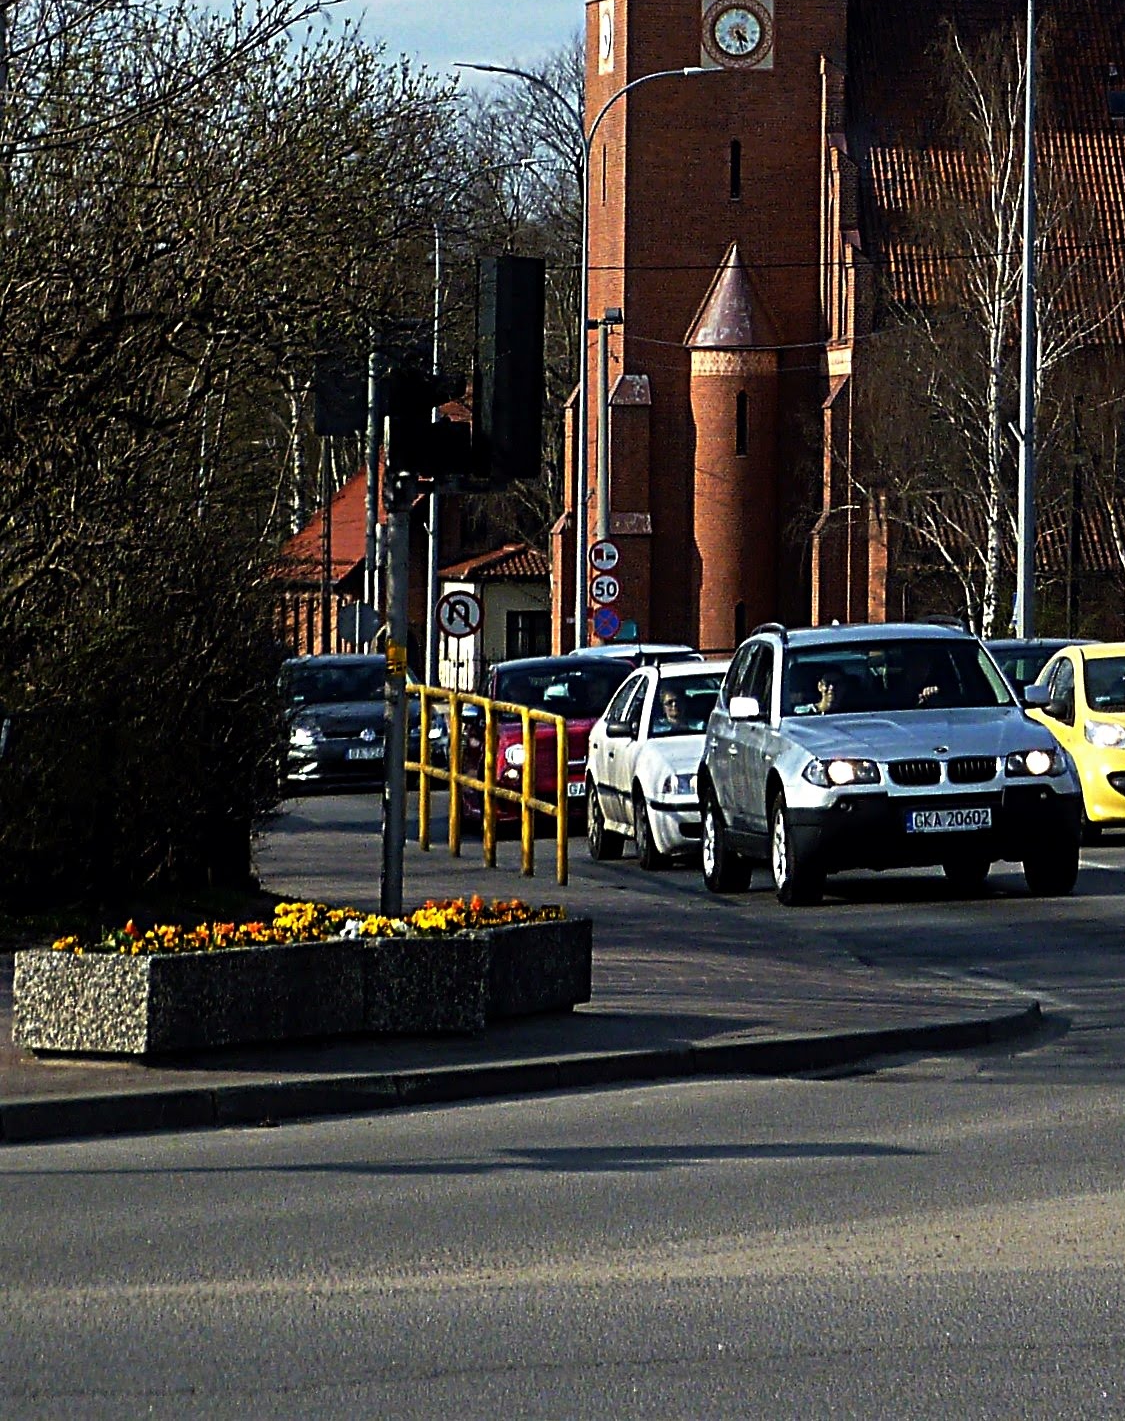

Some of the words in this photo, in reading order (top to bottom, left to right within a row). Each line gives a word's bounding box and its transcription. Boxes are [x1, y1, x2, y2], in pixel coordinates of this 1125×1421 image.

[595, 582, 618, 597] 50
[914, 811, 943, 829] GKA
[945, 809, 990, 827] 20602
